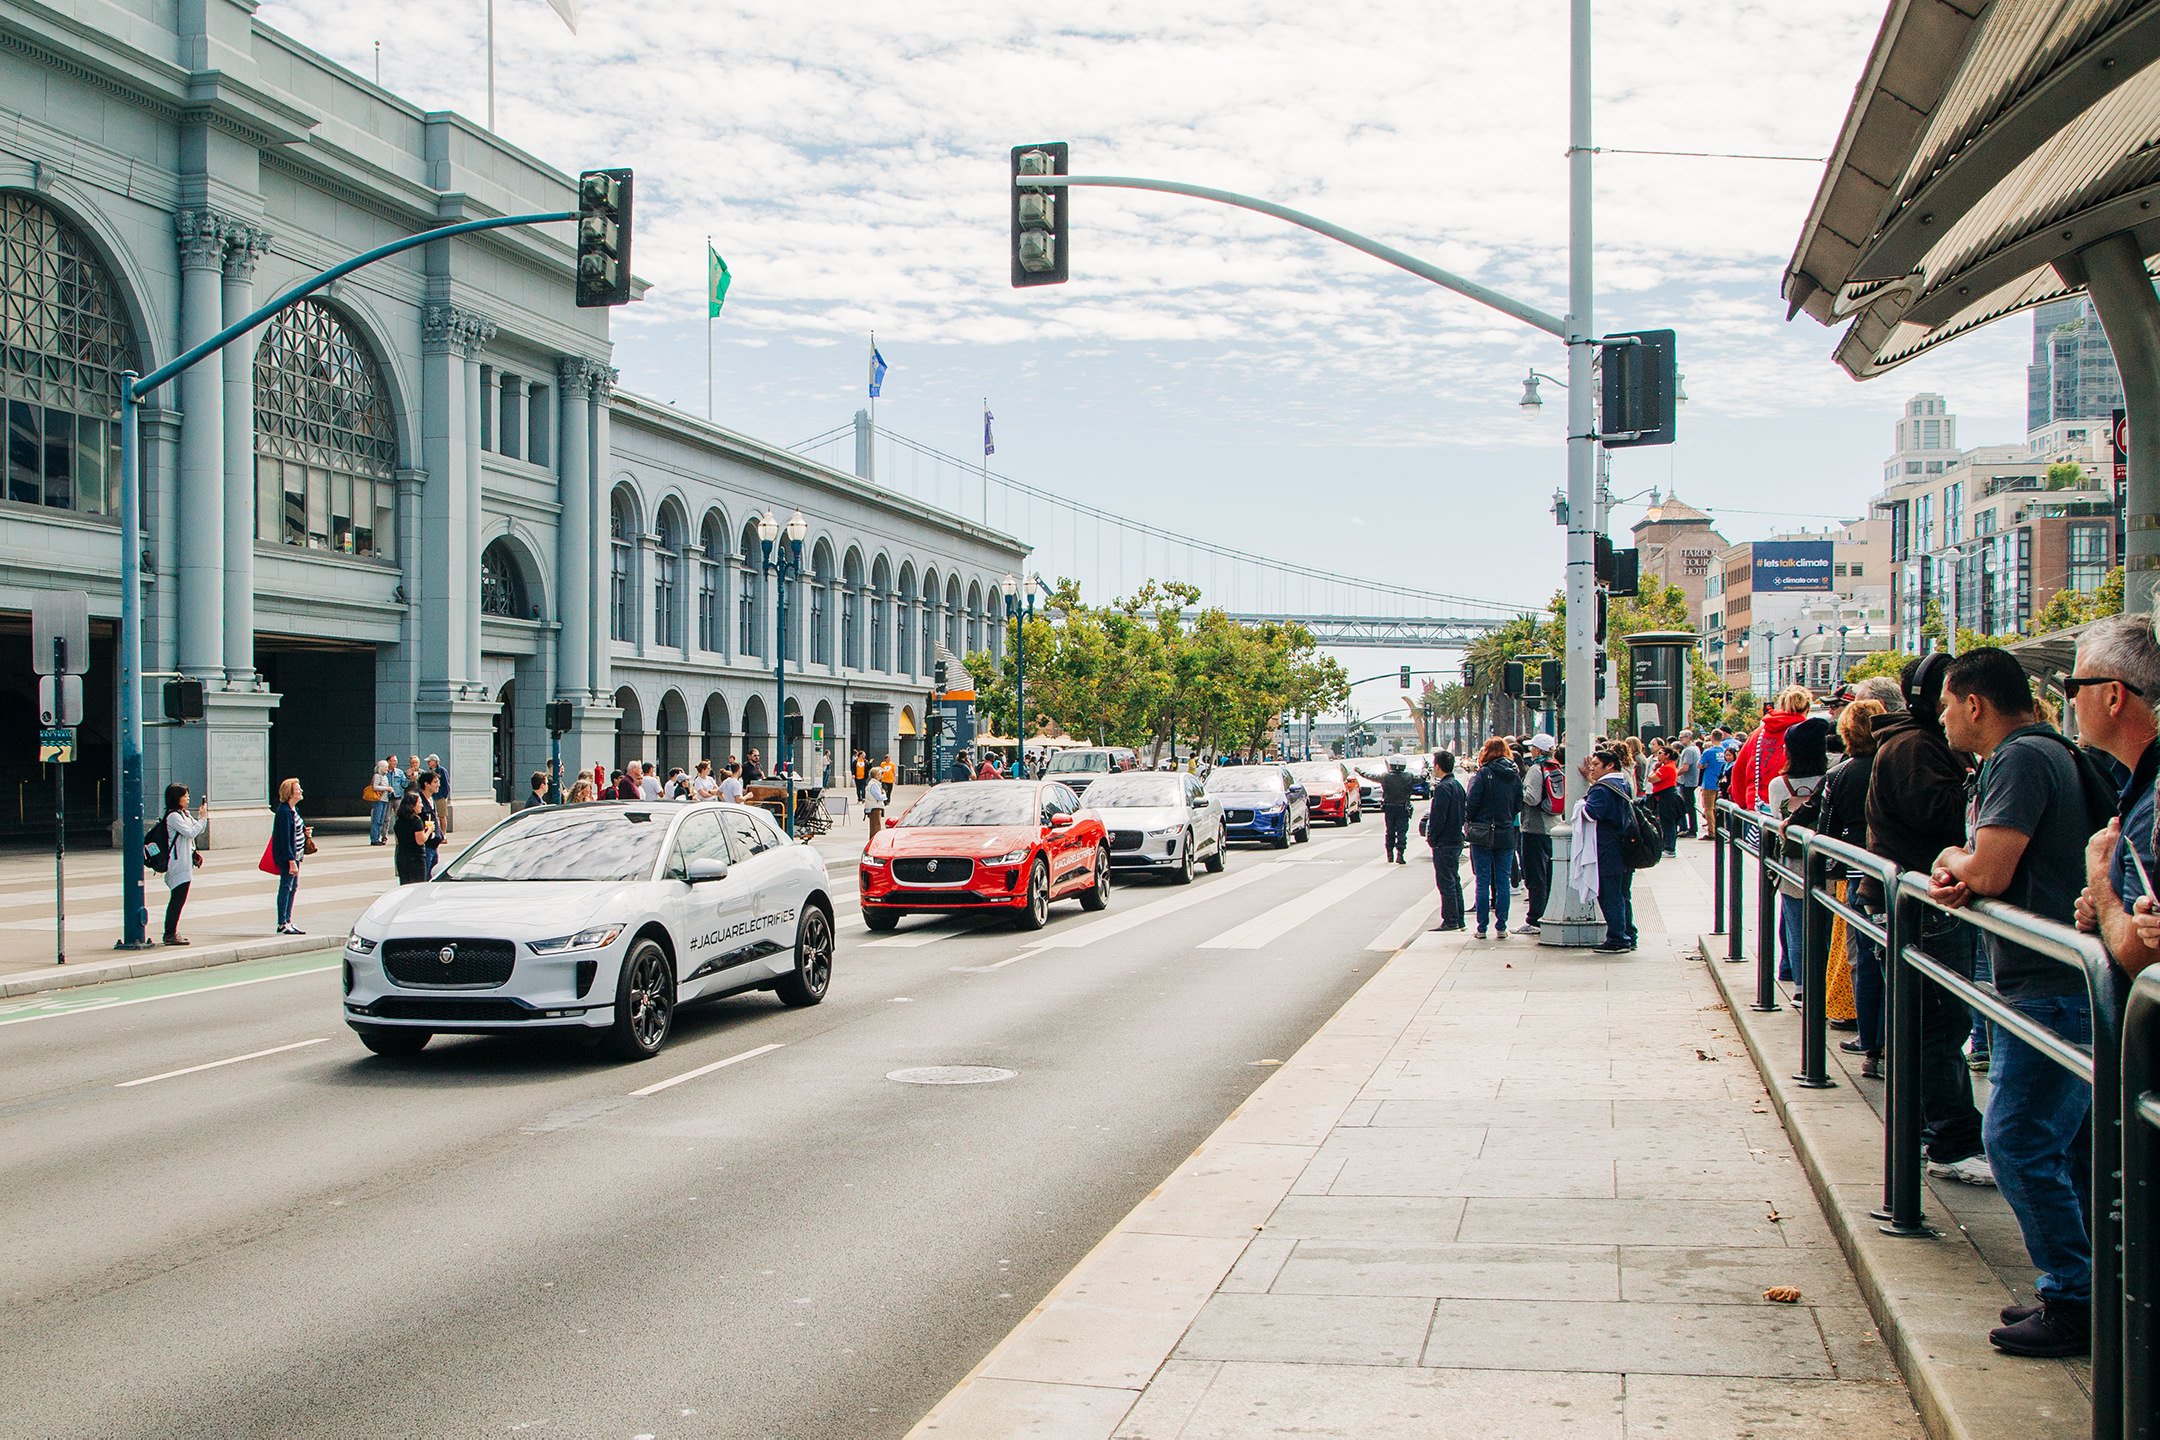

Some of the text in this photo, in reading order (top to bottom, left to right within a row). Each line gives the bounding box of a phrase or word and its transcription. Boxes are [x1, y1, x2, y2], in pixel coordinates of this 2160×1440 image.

[1683, 559, 1710, 567] COUR
[1756, 558, 1828, 568] #letstalkclimate
[1684, 567, 1707, 575] HOTE
[1782, 576, 1805, 584] climate
[690, 908, 795, 951] #JAGUARELECTRIFIES
